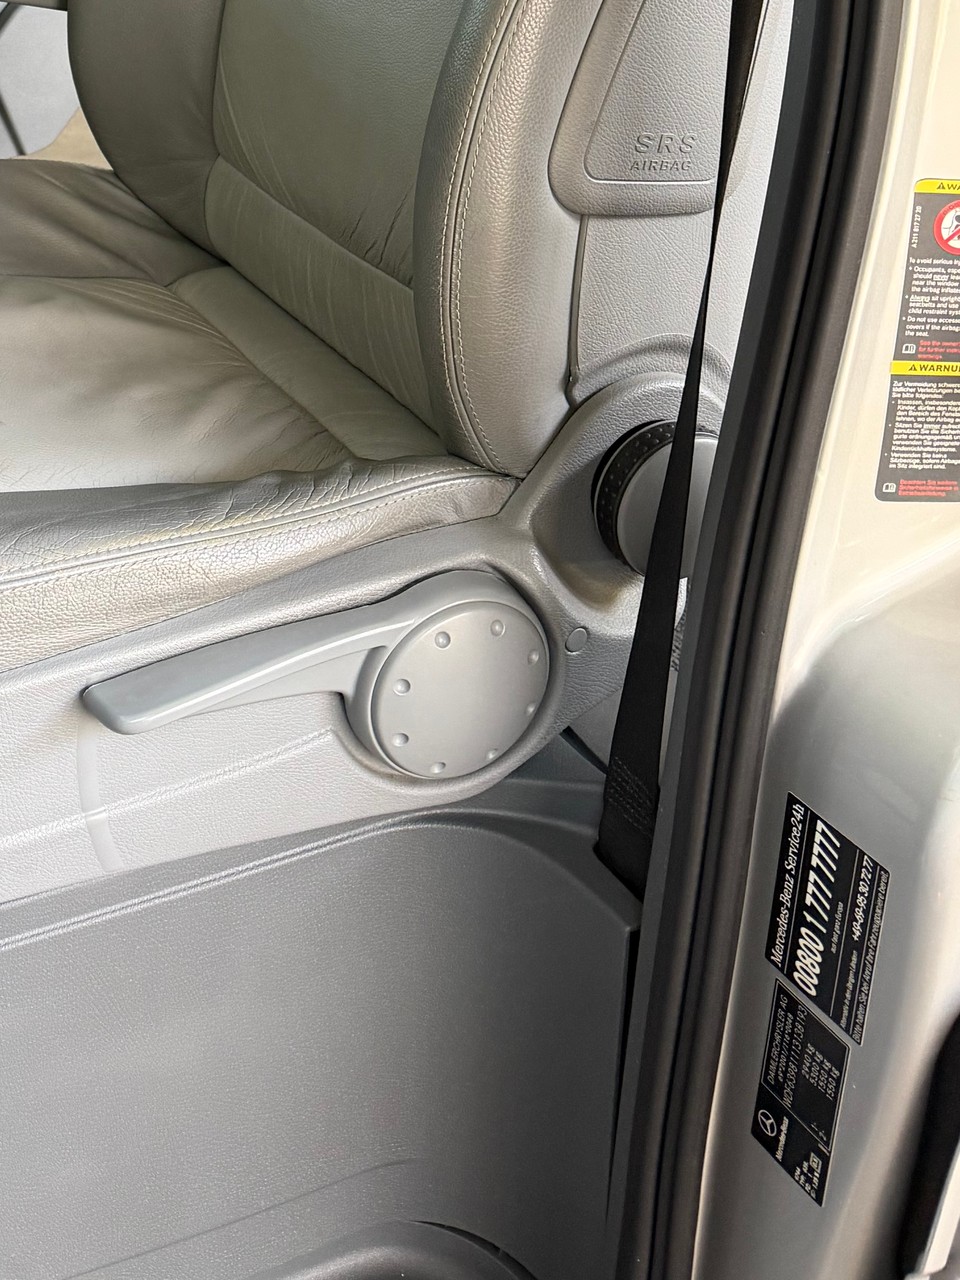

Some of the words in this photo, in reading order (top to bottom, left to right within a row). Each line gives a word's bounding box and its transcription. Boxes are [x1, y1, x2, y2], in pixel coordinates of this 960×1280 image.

[634, 132, 697, 153] SRS
[630, 160, 691, 171] AIRBAG
[810, 819, 840, 882] 7777
[862, 854, 873, 872] 77
[770, 873, 794, 967] Mercedes-Benz
[784, 803, 804, 874] Service24h
[860, 867, 871, 884] 72
[877, 870, 888, 894] bereit.
[805, 870, 832, 921] 777
[858, 880, 869, 896] 30
[802, 910, 826, 933] 1
[867, 892, 884, 950] Fahrzeugpapiere
[793, 927, 824, 995] 00800
[865, 948, 874, 963] Ihre
[862, 959, 872, 982] Anruf
[860, 979, 869, 994] bei
[858, 992, 867, 1005] Sie
[855, 1003, 865, 1025] halten
[767, 1008, 785, 1084] DAIMLERCHRYSLER
[779, 994, 788, 1009] AG
[852, 1024, 862, 1042] Bitte
[805, 1042, 815, 1055] kg
[813, 1050, 823, 1063] kg
[801, 1053, 811, 1079] 2940
[809, 1061, 819, 1086] 5300
[822, 1058, 831, 1071] kg
[829, 1066, 840, 1079] kg
[817, 1069, 828, 1092] 1550
[826, 1077, 836, 1100] 1550
